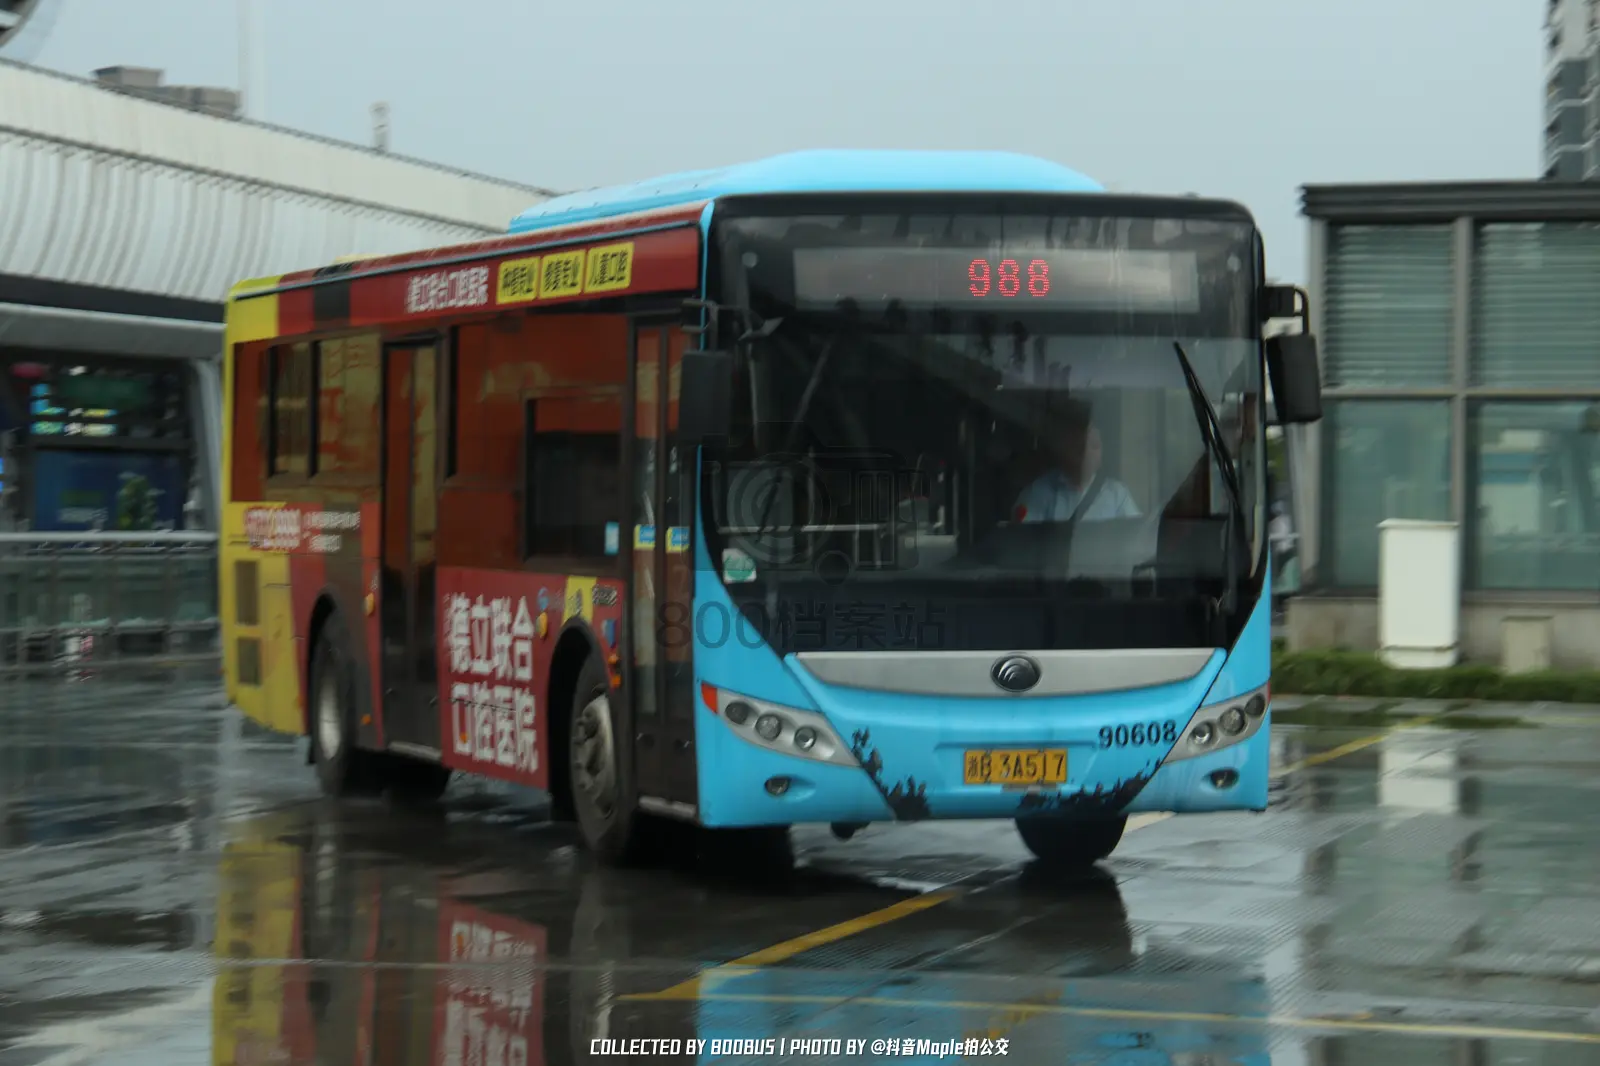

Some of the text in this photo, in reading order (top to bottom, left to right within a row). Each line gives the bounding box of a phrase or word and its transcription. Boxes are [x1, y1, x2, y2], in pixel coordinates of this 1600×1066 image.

[968, 259, 1050, 297] 988
[452, 682, 539, 774] 口腔医院
[1099, 720, 1177, 748] 90608
